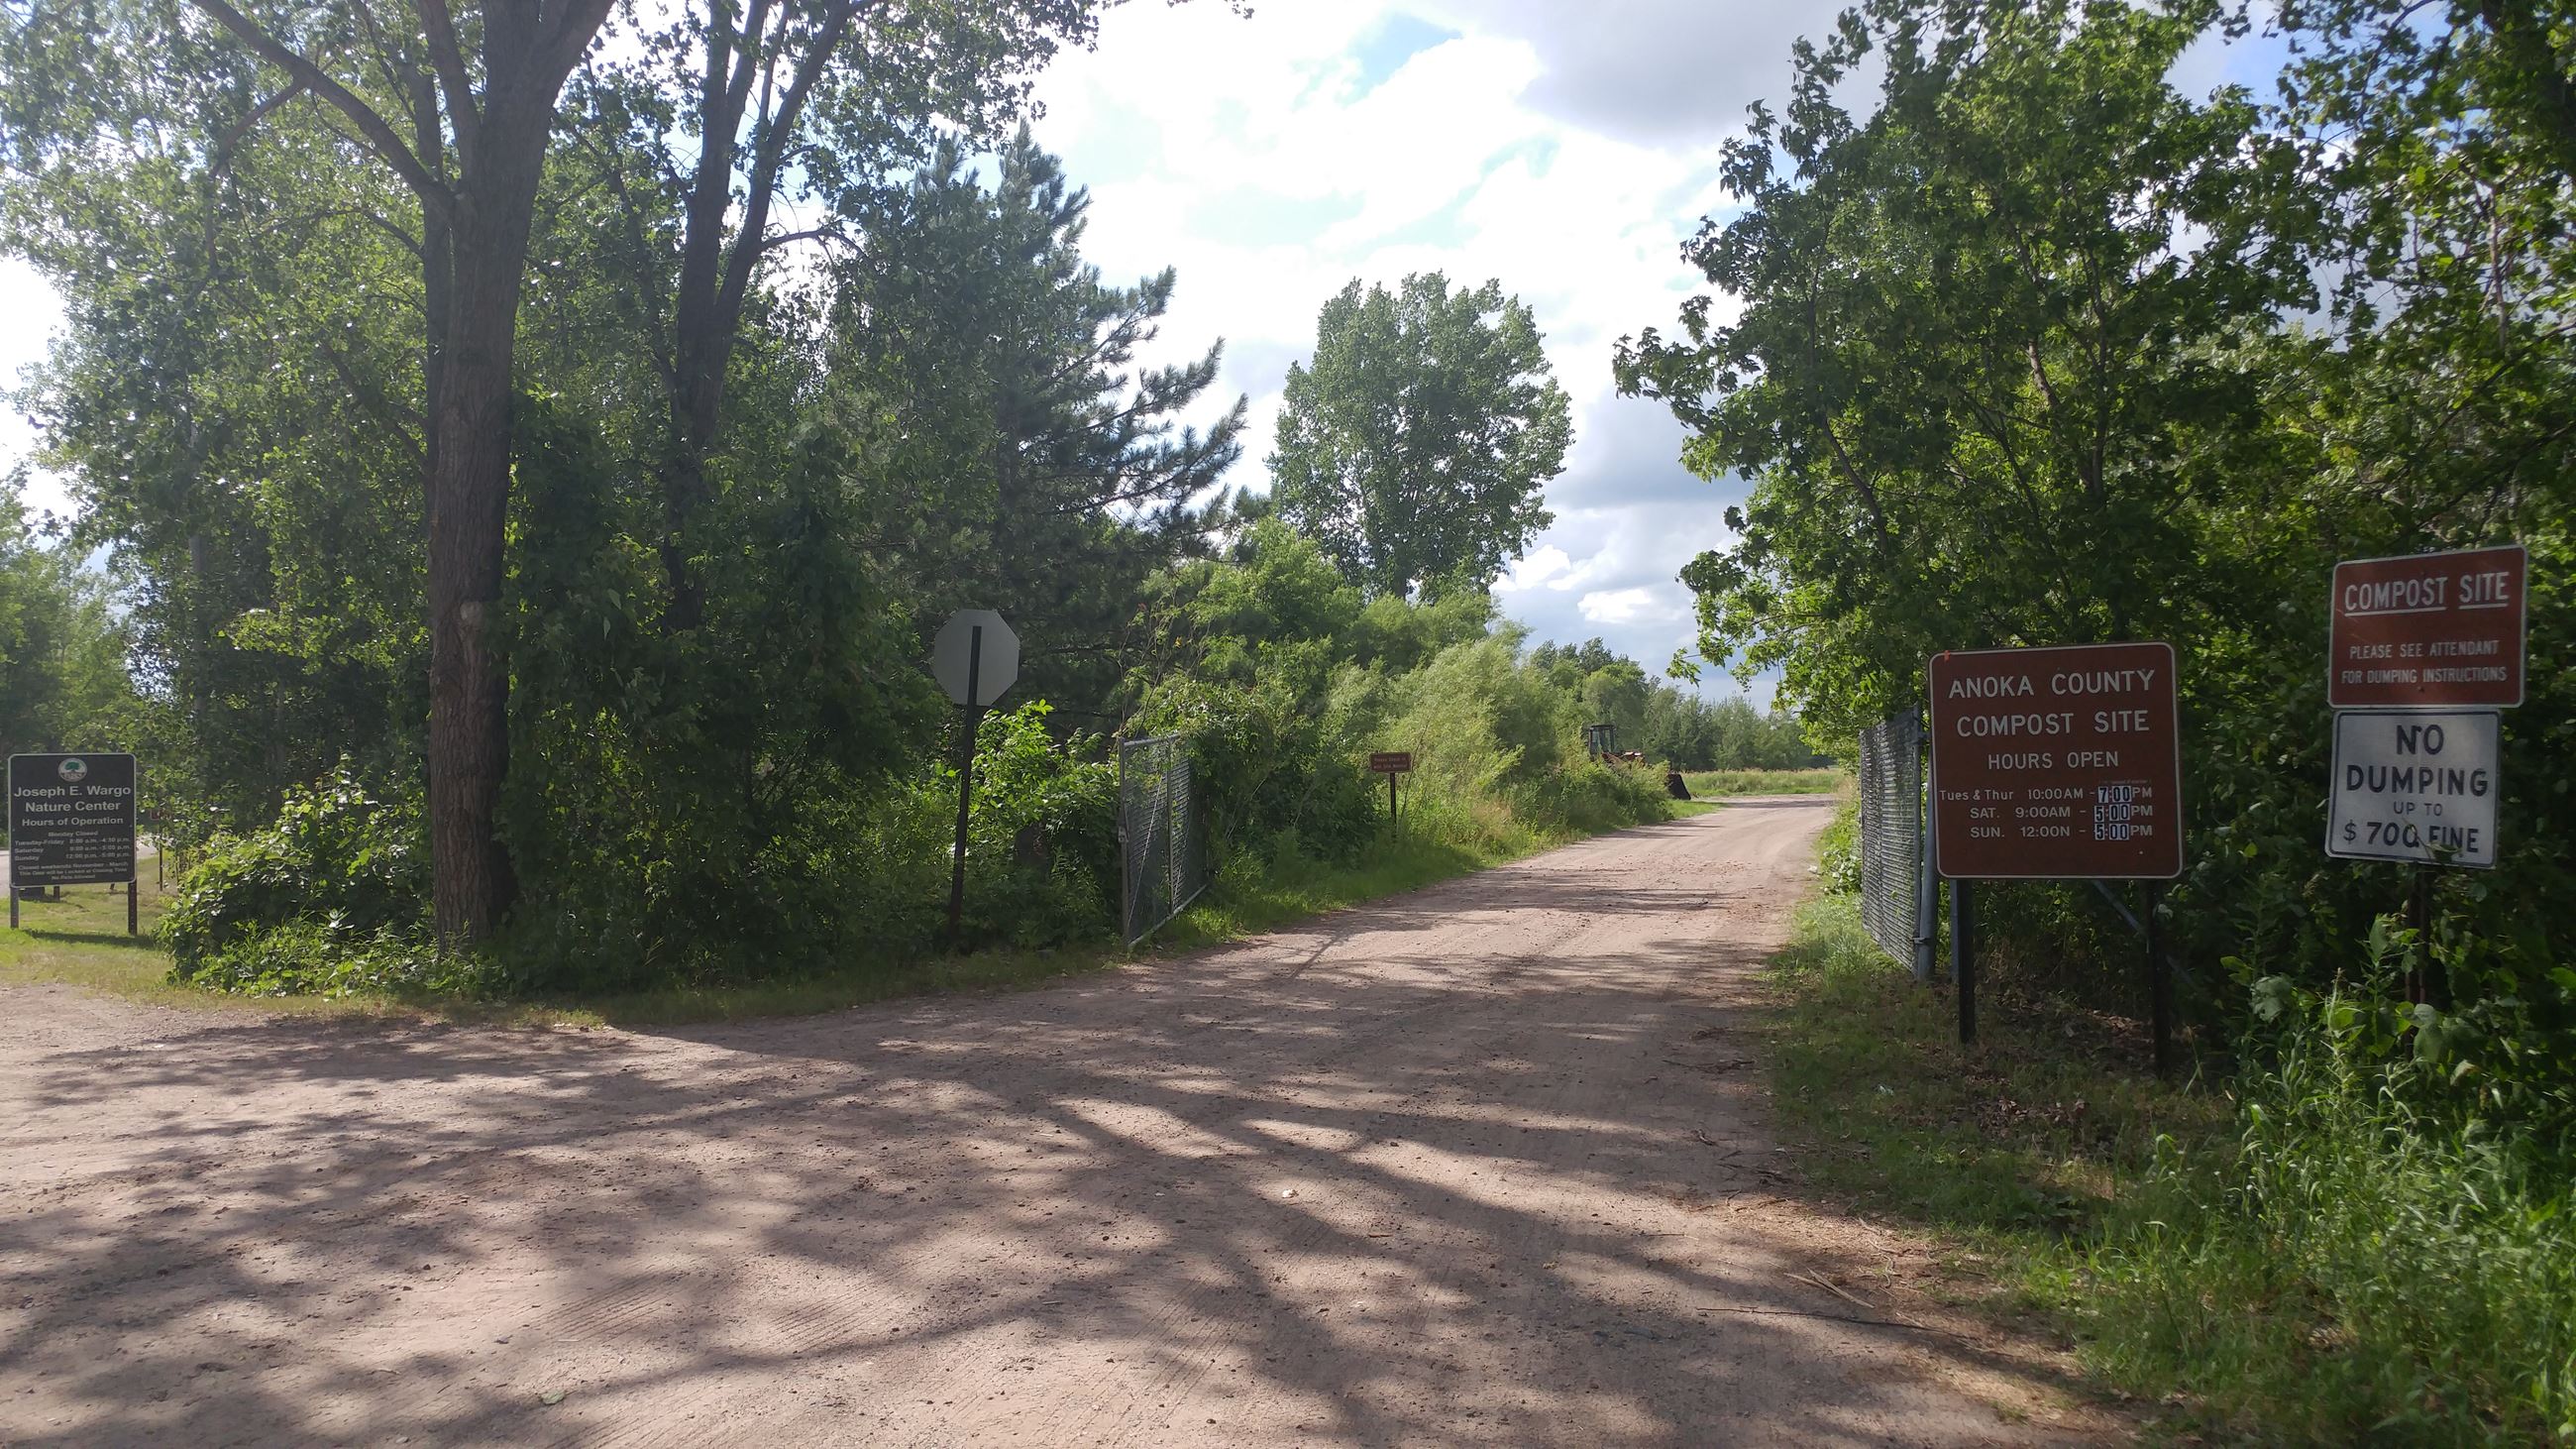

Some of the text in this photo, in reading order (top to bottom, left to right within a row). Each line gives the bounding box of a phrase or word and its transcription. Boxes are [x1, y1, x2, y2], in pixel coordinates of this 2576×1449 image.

[2345, 572, 2510, 612] COMPOST SITE
[2350, 640, 2499, 659] PLEASE SEE ATTENDANT
[1949, 668, 2155, 699] ANOKA COUNTY
[2342, 667, 2507, 684] FOR DUMPING INSTRUCTIONS
[1957, 710, 2149, 738] COMPOST SITE
[2396, 724, 2445, 755] NO
[1988, 751, 2119, 770] HOURS OPEN
[2346, 764, 2489, 796] DUMPING
[14, 786, 131, 798] Joseph E. Wargo
[1940, 790, 1968, 801] Tues
[1973, 790, 1981, 800] &
[1985, 789, 2014, 800] Thur
[2028, 788, 2083, 799] 10:00AM
[25, 801, 122, 812] Nature Center
[1970, 807, 1999, 819] SAT.
[2016, 806, 2071, 818] 9:00AM
[2393, 801, 2443, 816] UP TO
[71, 817, 123, 826] Operation
[1970, 826, 2004, 838] SUN.
[2021, 826, 2070, 837] 12:00N
[2429, 826, 2479, 853] FINE
